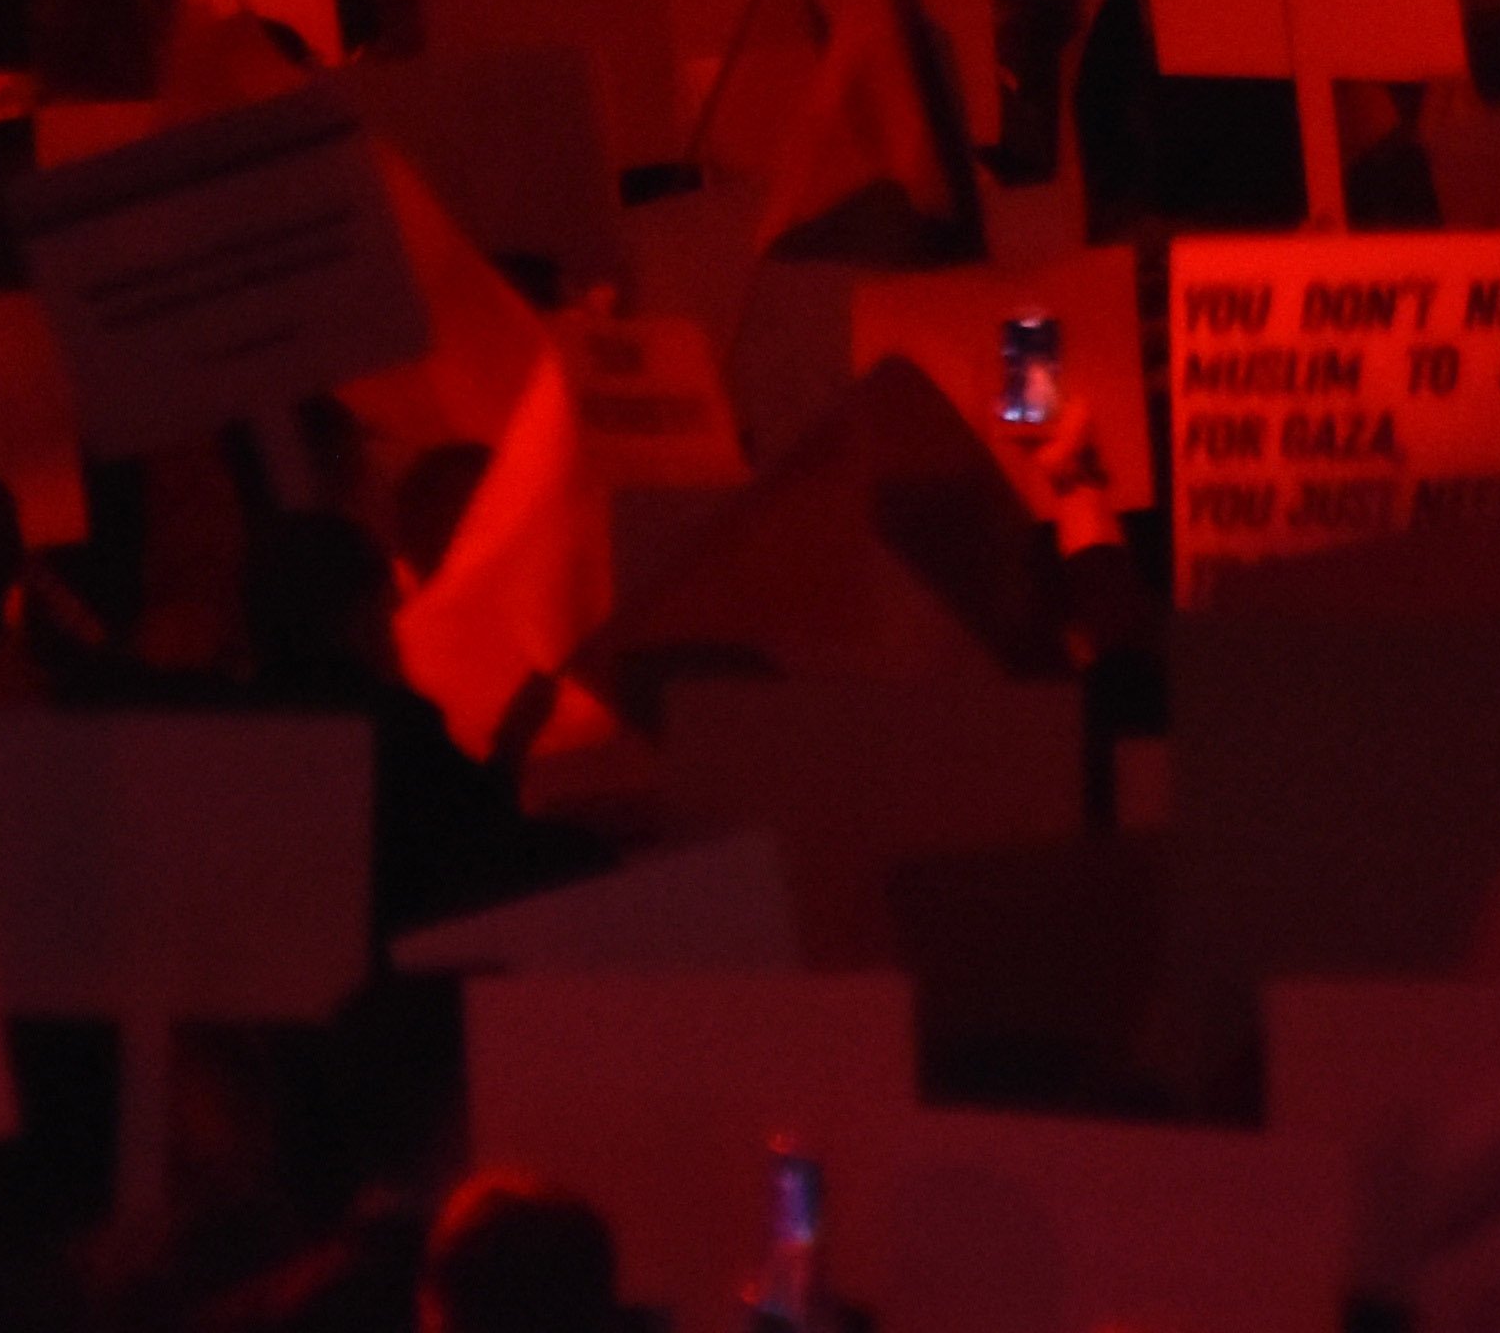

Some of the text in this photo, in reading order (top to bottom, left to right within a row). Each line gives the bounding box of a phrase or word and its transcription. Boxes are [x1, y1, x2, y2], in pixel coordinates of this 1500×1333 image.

[1186, 285, 1272, 332] YOU
[1185, 346, 1361, 395] MUSLIM
[1408, 344, 1459, 394] TO
[1185, 413, 1268, 461] FOR
[1188, 483, 1275, 531] YOU
